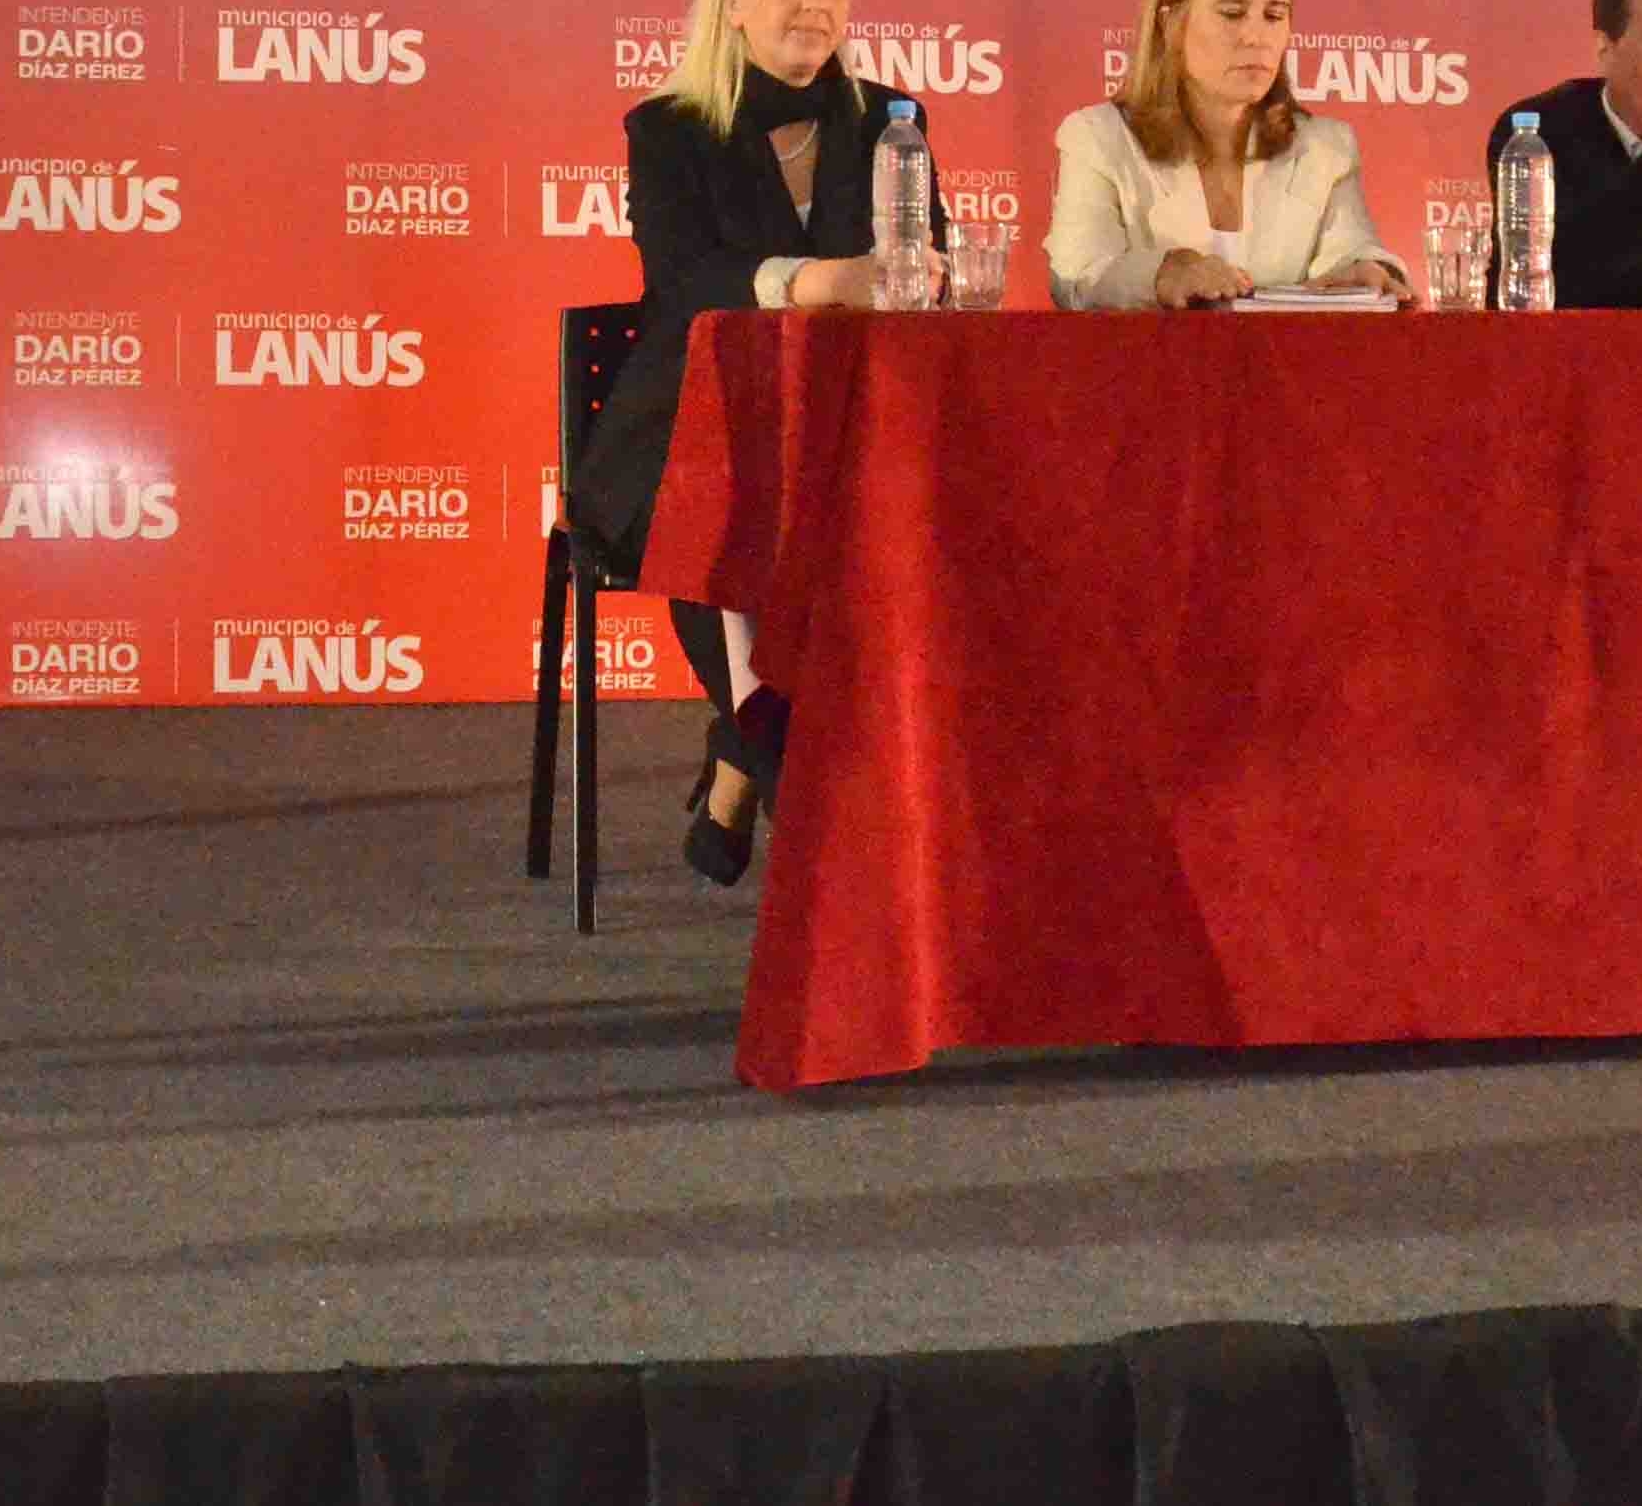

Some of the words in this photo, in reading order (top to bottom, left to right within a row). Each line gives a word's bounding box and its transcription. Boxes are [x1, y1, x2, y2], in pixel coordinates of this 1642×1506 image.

[218, 10, 333, 28] municipio
[19, 23, 144, 59] DARÍO
[218, 13, 426, 84] LANÚS
[846, 24, 1004, 94] ANÚS
[1291, 32, 1386, 51] municipio
[19, 60, 69, 78] DÍAZ
[75, 60, 145, 80] PÉREZ
[1286, 38, 1469, 105] LANÚS
[346, 179, 469, 215] DARÍO
[347, 216, 396, 234] DÍAZ
[401, 216, 470, 235] PÉREZ
[216, 312, 331, 330] municipio
[15, 328, 141, 364] DARÍO
[216, 314, 425, 386] LANÚS
[15, 365, 66, 385] DÍAZ
[71, 365, 142, 385] PÉREZ
[344, 482, 468, 518] DARÍO
[345, 520, 395, 539] DÍAZ
[400, 519, 469, 539] PÉREZ
[213, 618, 329, 637] municipio
[12, 636, 139, 673] DARÍO
[214, 619, 424, 693] LANÚS
[12, 675, 63, 695] DÍAZ
[69, 674, 139, 694] PÉREZ
